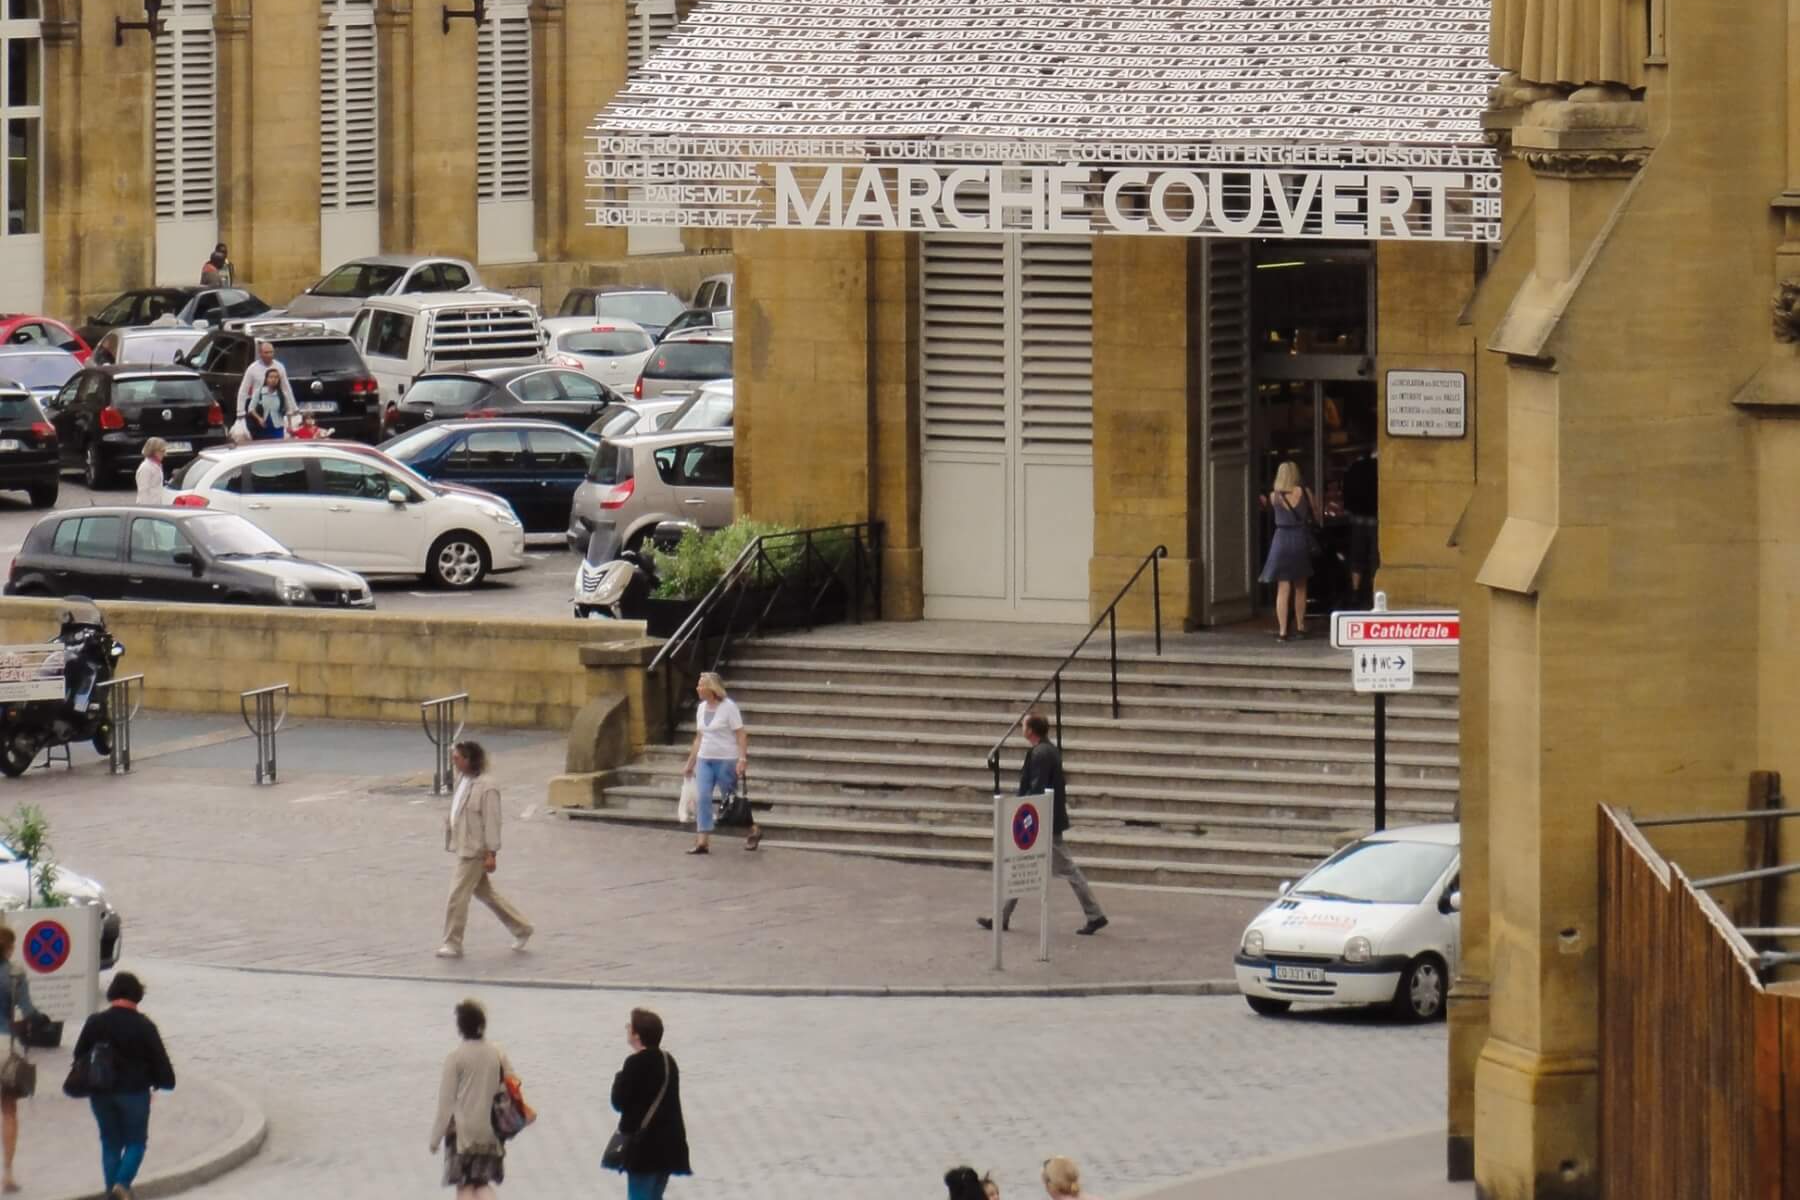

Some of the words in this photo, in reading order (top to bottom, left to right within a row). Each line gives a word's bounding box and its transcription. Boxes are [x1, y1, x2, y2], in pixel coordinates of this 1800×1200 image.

[686, 13, 766, 24] POTAGE
[766, 17, 798, 25] AU
[909, 19, 970, 28] DAUBE
[972, 20, 998, 28] DE
[1088, 20, 1114, 29] LA
[1247, 21, 1275, 30] DE
[678, 38, 775, 48] MUNSTER
[868, 42, 936, 50] TRUITE
[938, 42, 970, 50] AU
[1041, 43, 1106, 53] PERLE
[1106, 45, 1136, 53] DE
[1253, 44, 1345, 54] POISSON
[1366, 44, 1392, 53] LA
[643, 60, 689, 69] GRIS
[689, 61, 718, 70] DE
[782, 64, 861, 73] TOURTE
[863, 66, 898, 74] AUX
[1053, 67, 1114, 77] TARTE
[1117, 69, 1157, 78] AUX
[1358, 69, 1389, 78] DE
[627, 83, 690, 93] PERLE
[691, 86, 720, 95] DE
[840, 89, 922, 98] JAMBON
[923, 88, 962, 97] AUX
[1094, 93, 1203, 103] MATELOTE
[1311, 92, 1393, 102] FUSEAU
[612, 108, 691, 118] SALADE
[692, 110, 724, 119] DE
[724, 111, 830, 121] PISSENLITS
[852, 112, 876, 121] LA
[883, 112, 962, 121] CHAUDE
[1250, 116, 1323, 126] SOUPE
[597, 138, 650, 154] PORC
[702, 140, 742, 155] AUX
[748, 141, 870, 161] MIRABELLES,
[879, 142, 956, 158] TOURTE
[1068, 145, 1158, 161] COCHON
[1163, 145, 1190, 161] DE
[1195, 146, 1237, 162] LAIT
[1243, 147, 1273, 163] EN
[1350, 148, 1442, 165] POISSON
[1447, 145, 1464, 166] À
[1468, 150, 1496, 167] LA
[586, 161, 660, 178] QUICHE
[775, 161, 1090, 233] MARCHÉ
[1103, 168, 1465, 238] COUVERT
[595, 209, 672, 226] BOULET
[674, 210, 701, 226] DE
[1369, 623, 1449, 638] Cathédrale
